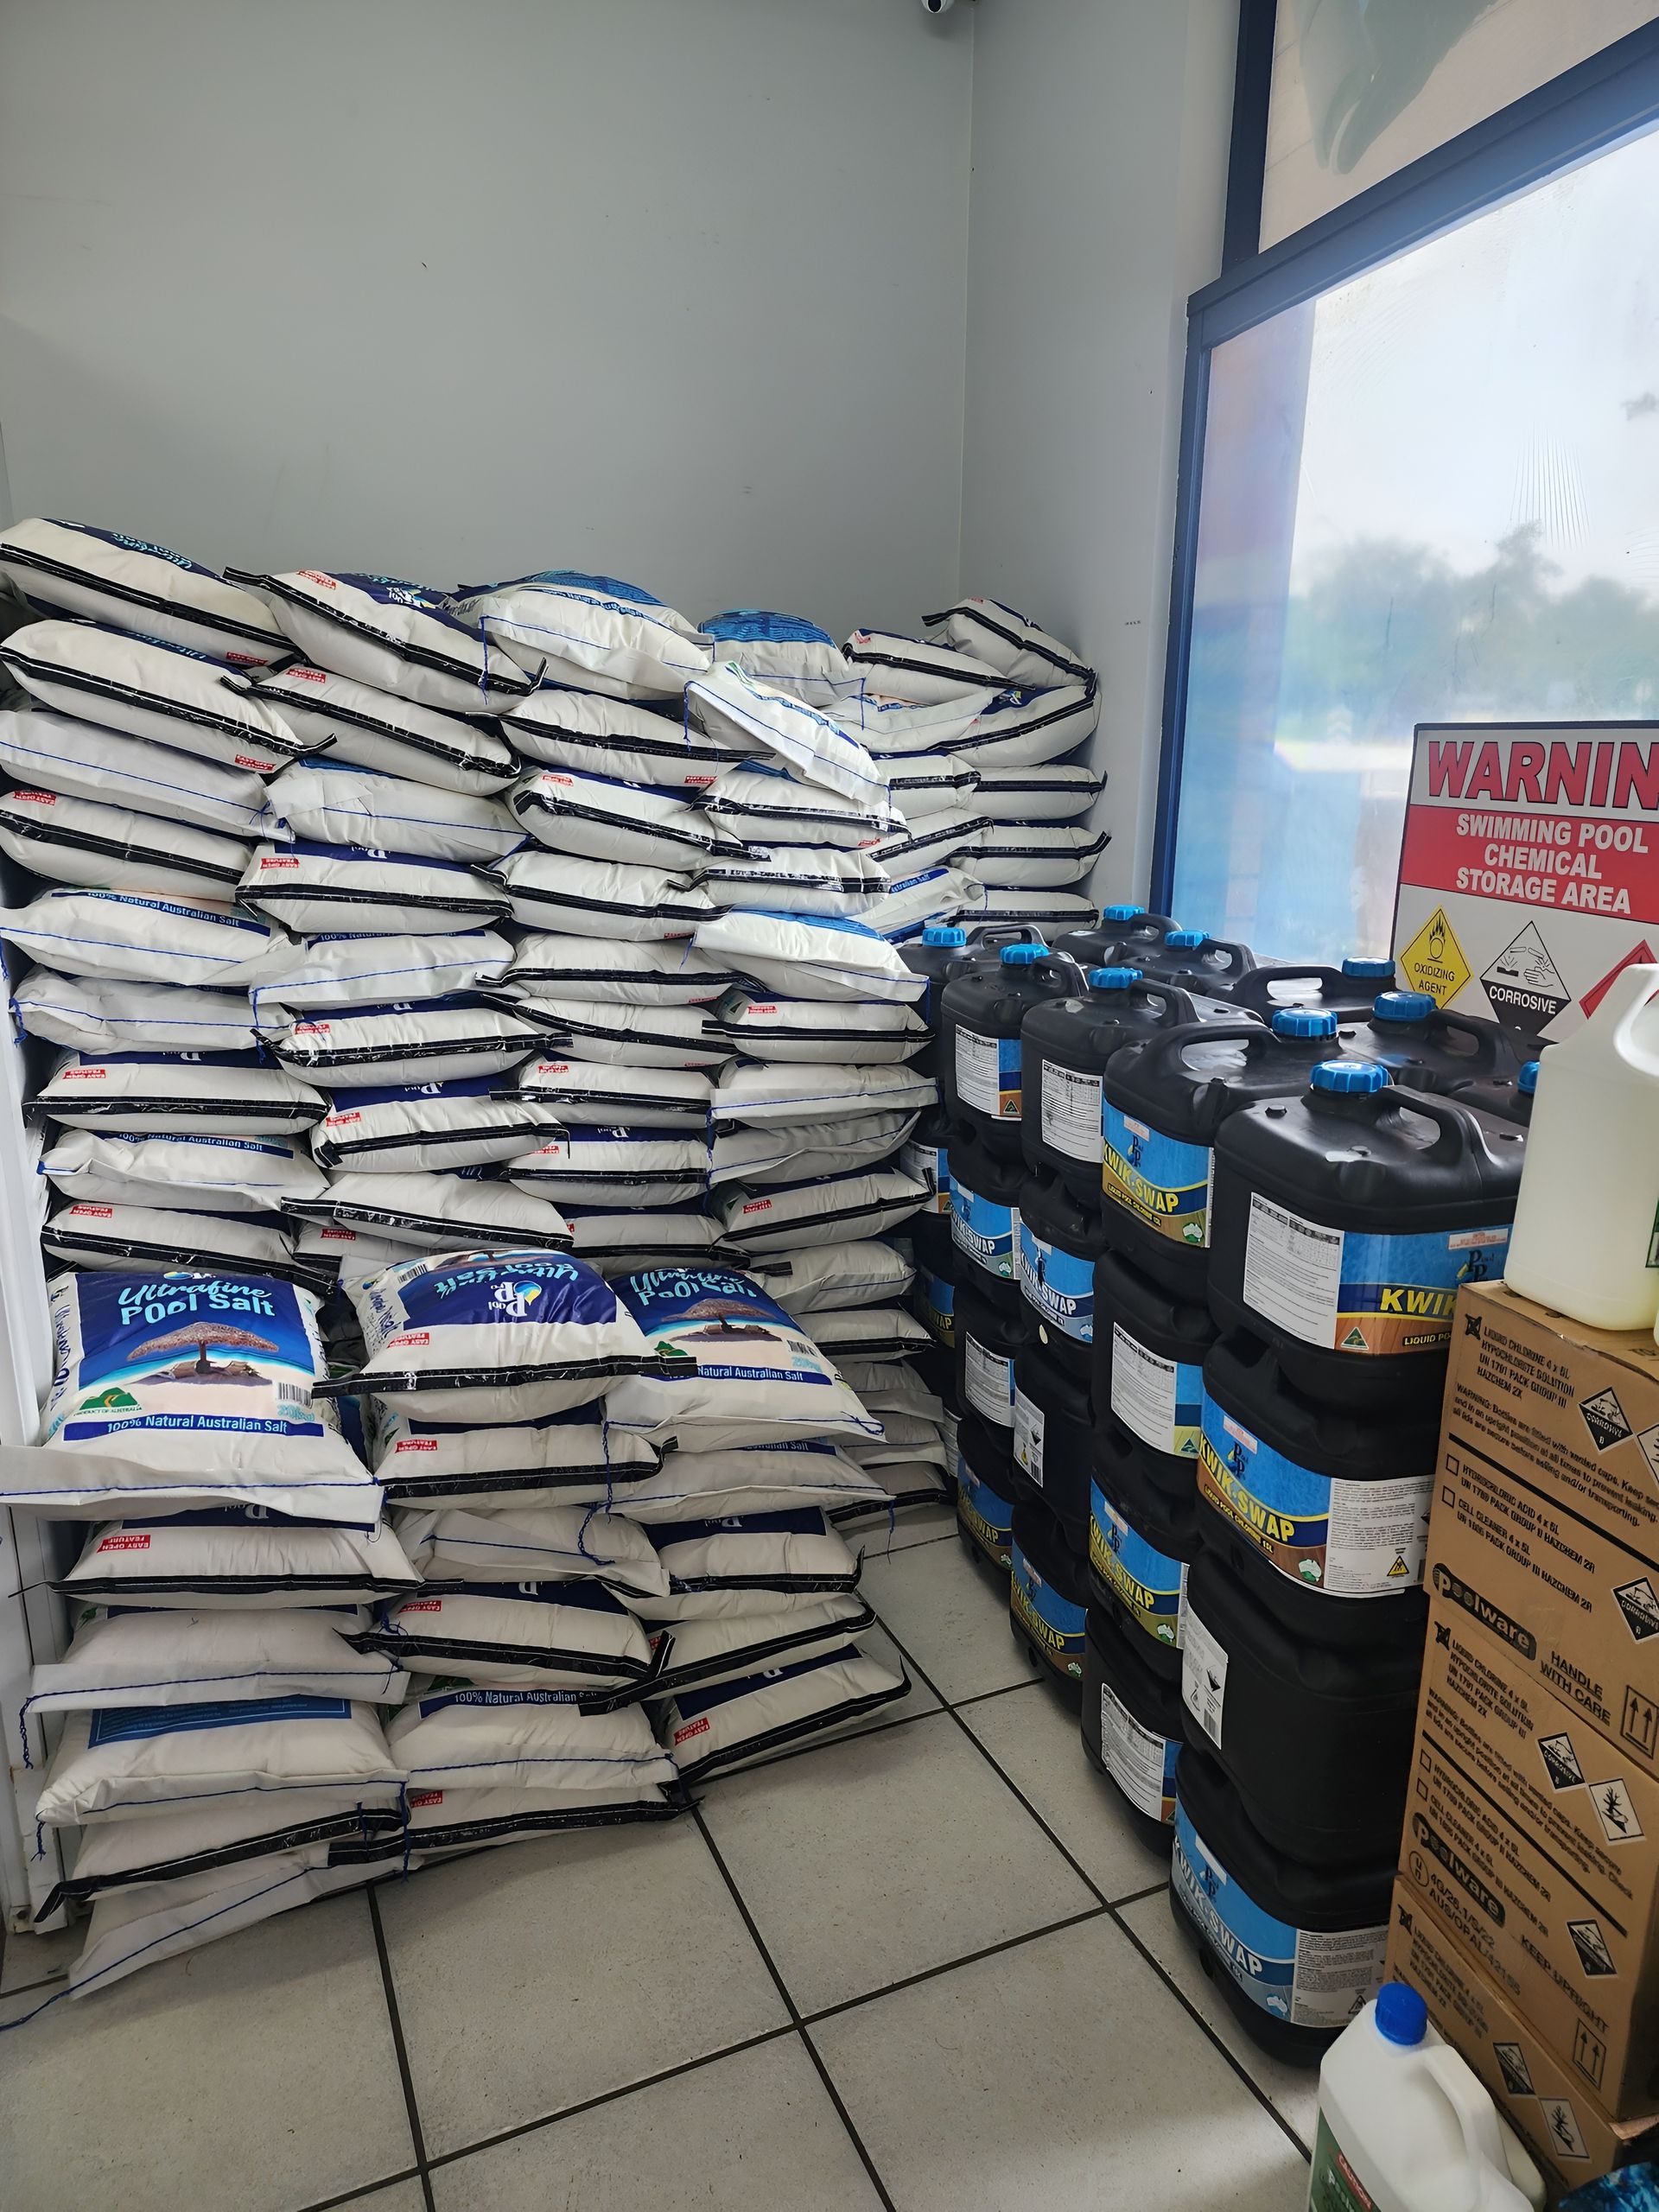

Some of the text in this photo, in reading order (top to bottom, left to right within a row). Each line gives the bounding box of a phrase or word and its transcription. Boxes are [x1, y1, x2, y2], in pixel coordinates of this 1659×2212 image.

[1428, 741, 1659, 810] WARNIN
[1456, 814, 1649, 854] SWIMMING POOL
[1484, 843, 1602, 880] CHEMICAL
[1456, 867, 1630, 914] STORAGE AREA
[119, 895, 160, 909] Natural
[162, 902, 217, 922] Australian
[219, 915, 240, 927] Salt
[1414, 963, 1455, 982] OXIDIZING
[1418, 979, 1447, 996] AGENT
[1489, 984, 1557, 1015] CORROSIVE
[188, 1135, 241, 1148] Australian
[245, 1141, 263, 1152] Salt
[1103, 1143, 1179, 1213] KWIK-SWAP
[118, 1280, 272, 1306] Ultrafine
[488, 1294, 529, 1318] Pool
[121, 1294, 276, 1325] Pool Salt
[1404, 1335, 1435, 1346] LIQUID
[697, 1366, 733, 1377] Natural
[734, 1367, 784, 1379] Australian
[785, 1371, 804, 1382] Salt
[107, 1415, 288, 1433] 100% Natural Australian Salt
[791, 1442, 810, 1452] Salt
[1199, 1433, 1295, 1542] KWIK-SWAP
[1550, 1648, 1603, 1703] HANDLE
[454, 1691, 483, 1703] 100%
[486, 1691, 524, 1705] Natural
[526, 1691, 577, 1703] Australian
[1540, 1657, 1611, 1727] WITH CARE
